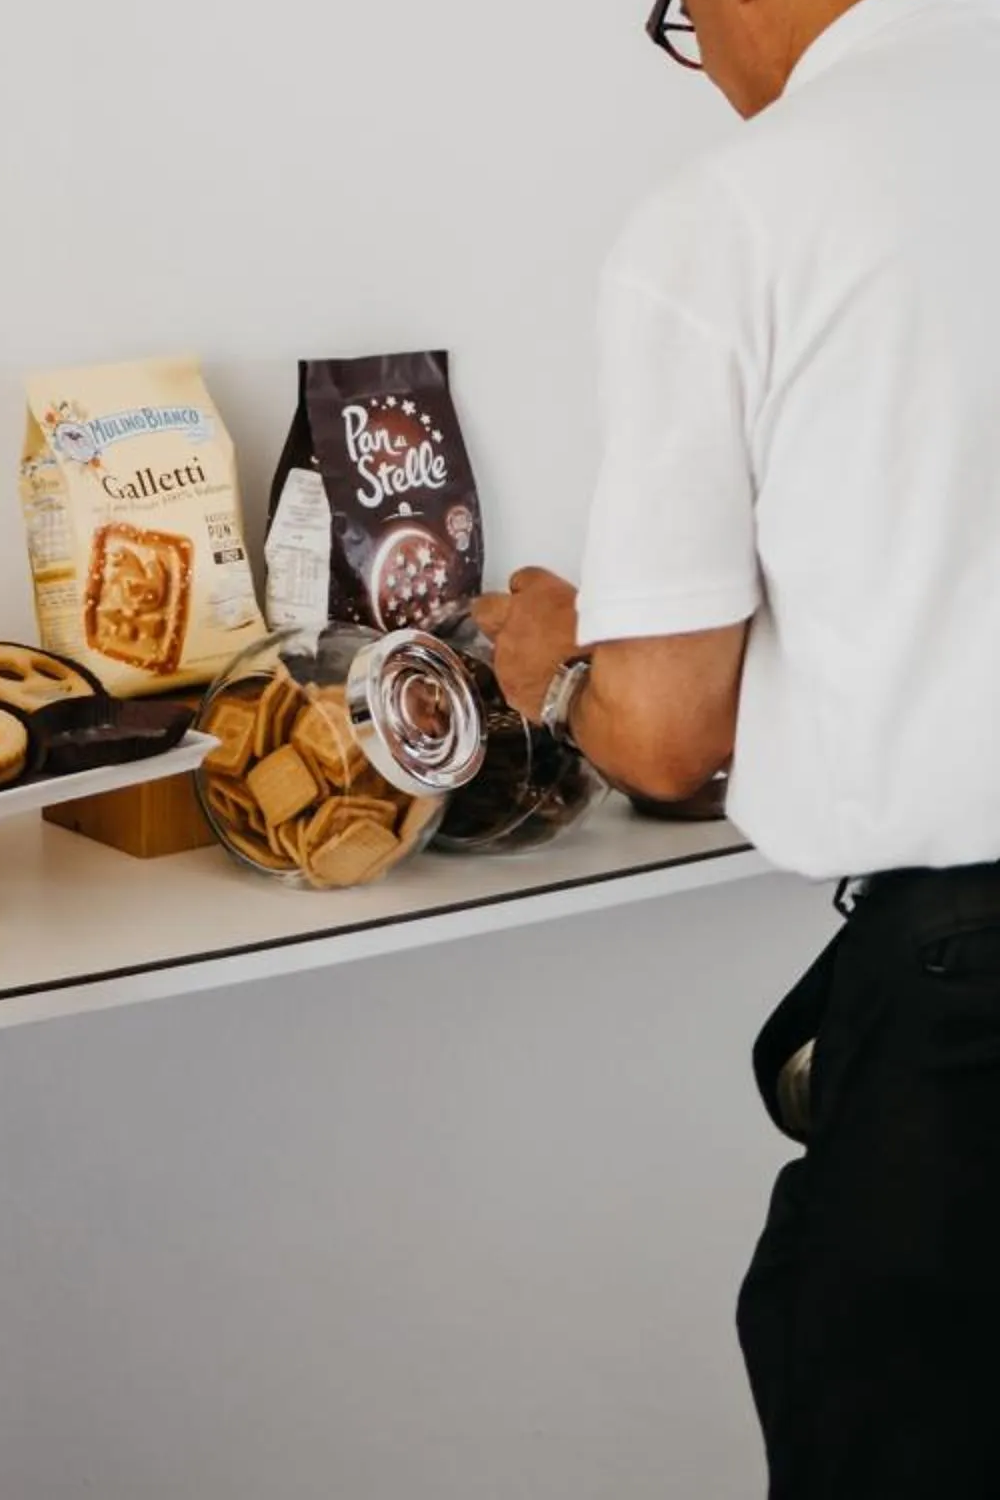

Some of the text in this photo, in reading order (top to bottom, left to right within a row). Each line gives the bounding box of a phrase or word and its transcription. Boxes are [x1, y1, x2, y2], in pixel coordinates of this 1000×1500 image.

[341, 405, 402, 462] Pan
[102, 456, 206, 499] Galletti
[356, 440, 448, 509] Stelle
